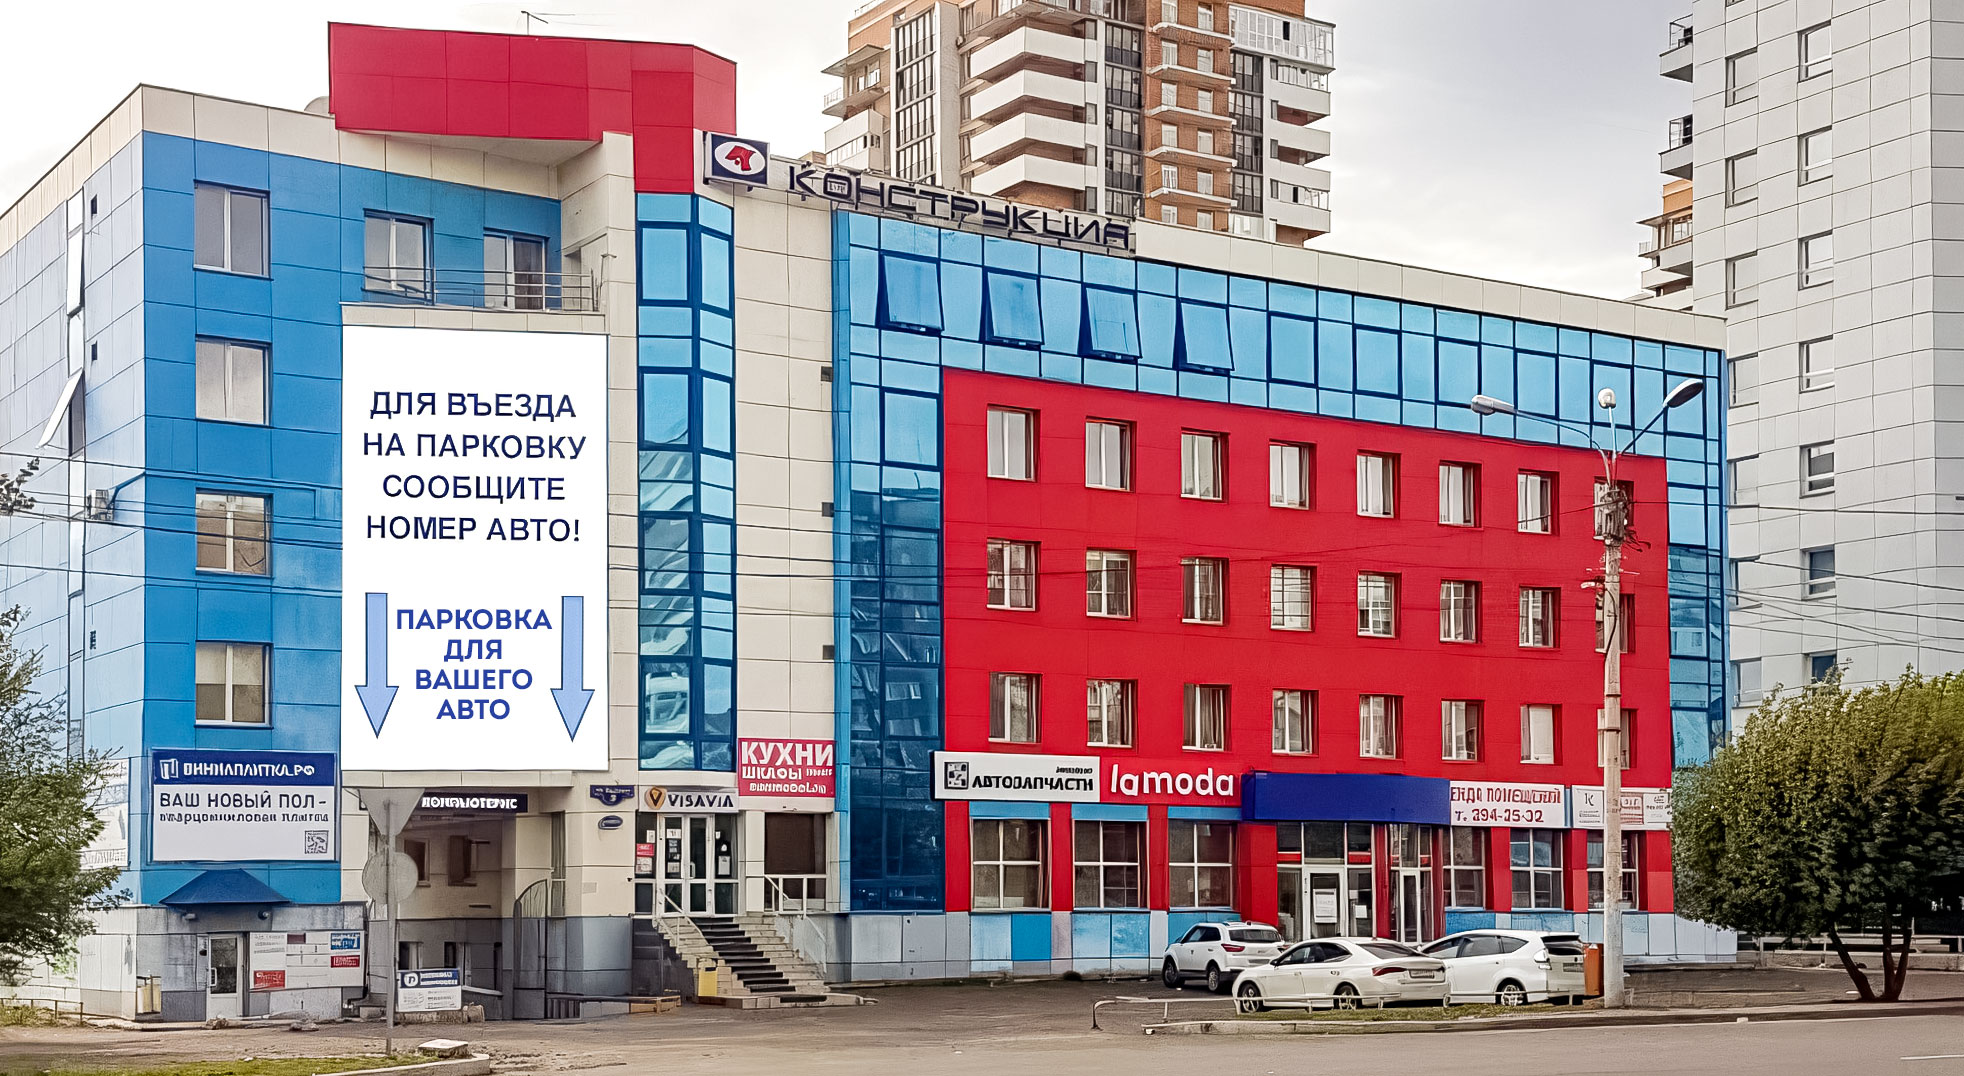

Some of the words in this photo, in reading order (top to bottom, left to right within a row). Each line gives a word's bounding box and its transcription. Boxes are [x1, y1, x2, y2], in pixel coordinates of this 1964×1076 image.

[788, 165, 1130, 249] КОНСТРУКЦИЯ
[369, 391, 437, 420] ДЛЯ
[447, 392, 577, 423] ВЪЕЗДА
[363, 432, 405, 457] НА
[416, 433, 587, 460] ПАРКОВКУ
[382, 474, 566, 505] СООБЩИТЕ
[366, 514, 477, 541] НОМЕР
[486, 517, 580, 542] АВТО!
[396, 608, 553, 630] ПАРКОВКА
[443, 639, 503, 663] ДЛЯ
[415, 668, 533, 691] ВАШЕГО
[436, 698, 511, 720] АВТО
[741, 741, 834, 767] КУХНИ
[1110, 763, 1235, 797] lamoda
[160, 792, 200, 808] ВАШ
[207, 790, 272, 809] НОВЫЙ
[279, 793, 315, 809] ПОЛ
[667, 793, 735, 808] VISAVIA
